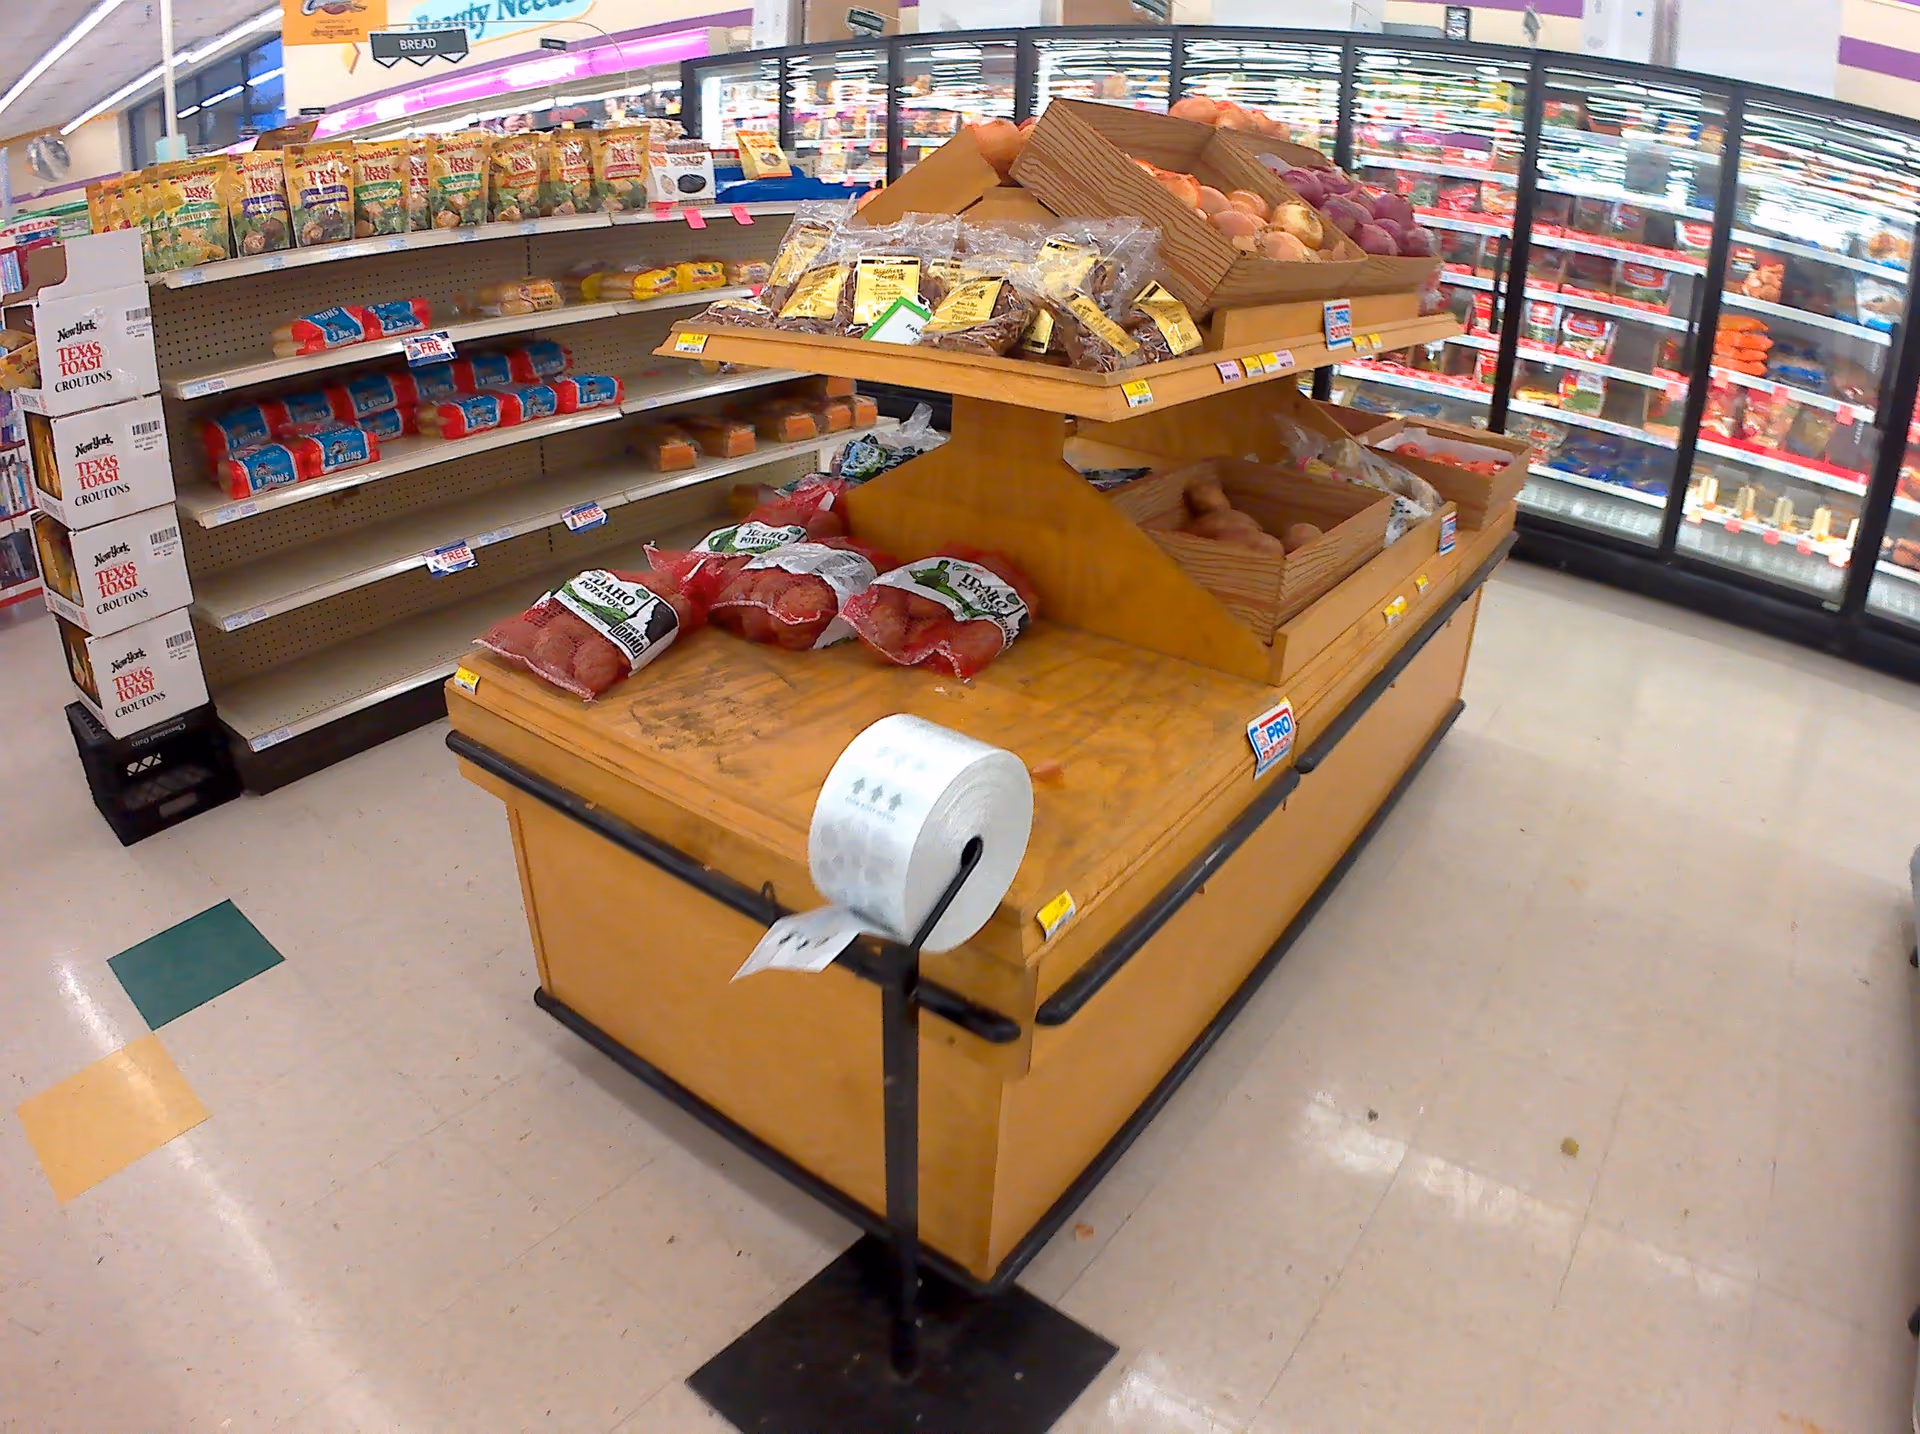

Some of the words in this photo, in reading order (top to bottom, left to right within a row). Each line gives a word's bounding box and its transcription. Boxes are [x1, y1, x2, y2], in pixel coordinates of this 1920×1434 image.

[399, 38, 437, 51] BREAD
[56, 341, 102, 362] TEXAS
[58, 354, 103, 377] TOAST
[55, 370, 112, 393] CROUTONS
[75, 454, 119, 477] TEXAS
[337, 450, 363, 463] BUNS
[77, 467, 121, 490] TOAST
[75, 483, 131, 507] CROUTONS
[577, 506, 602, 522] FREE
[441, 546, 470, 563] FREE
[95, 561, 137, 586] TEXAS
[98, 573, 138, 599] TOAST
[579, 579, 627, 612] POTATOES
[588, 577, 636, 607] IDAHO
[960, 572, 1008, 608] IDAHO
[96, 588, 149, 615] CROUTONS
[613, 625, 644, 654] IDAHO
[112, 666, 154, 691] TEXAS
[116, 678, 155, 703] TOAST
[115, 691, 167, 719] CROUTONS
